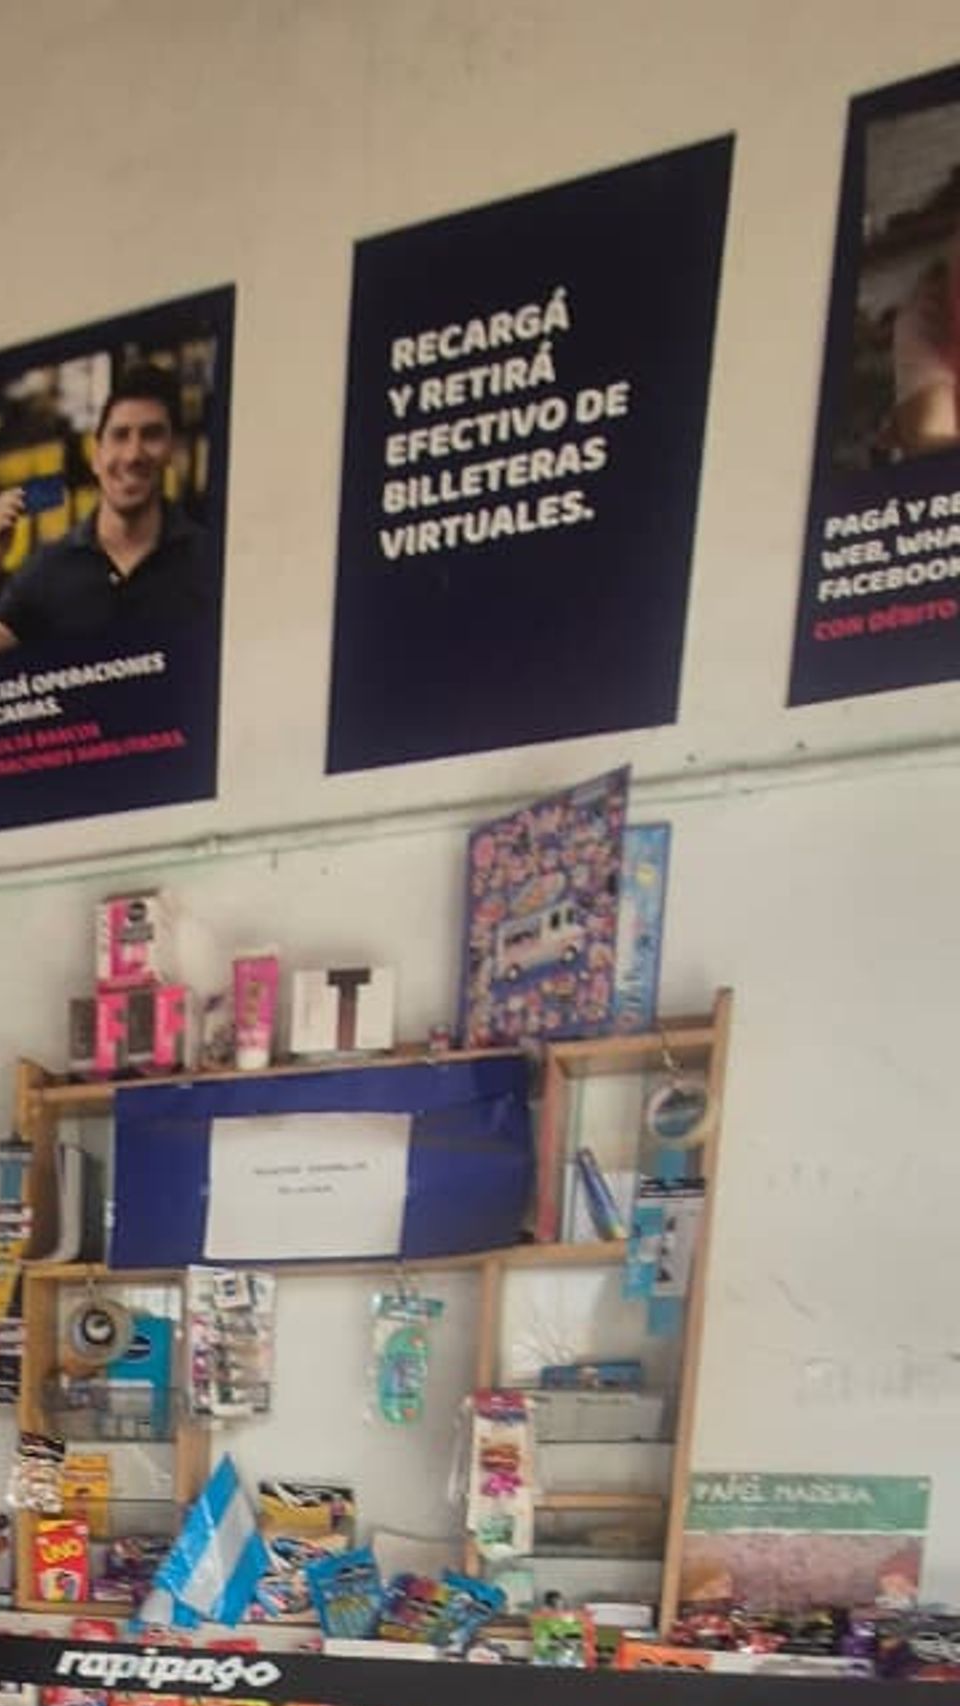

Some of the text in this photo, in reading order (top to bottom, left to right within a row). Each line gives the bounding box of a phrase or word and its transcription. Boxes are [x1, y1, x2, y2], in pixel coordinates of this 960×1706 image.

[391, 287, 570, 373] RECARGÁ
[388, 341, 556, 419] Y RETIRÁ
[385, 379, 631, 467] EFECTIVO DE
[382, 436, 608, 514] BILLETERAS
[379, 491, 595, 560] VIRTUALES.
[824, 498, 901, 540] PAGÁ
[905, 499, 927, 524] Y
[30, 651, 167, 694] OPERACIONES
[55, 1647, 282, 1691] rapipago
